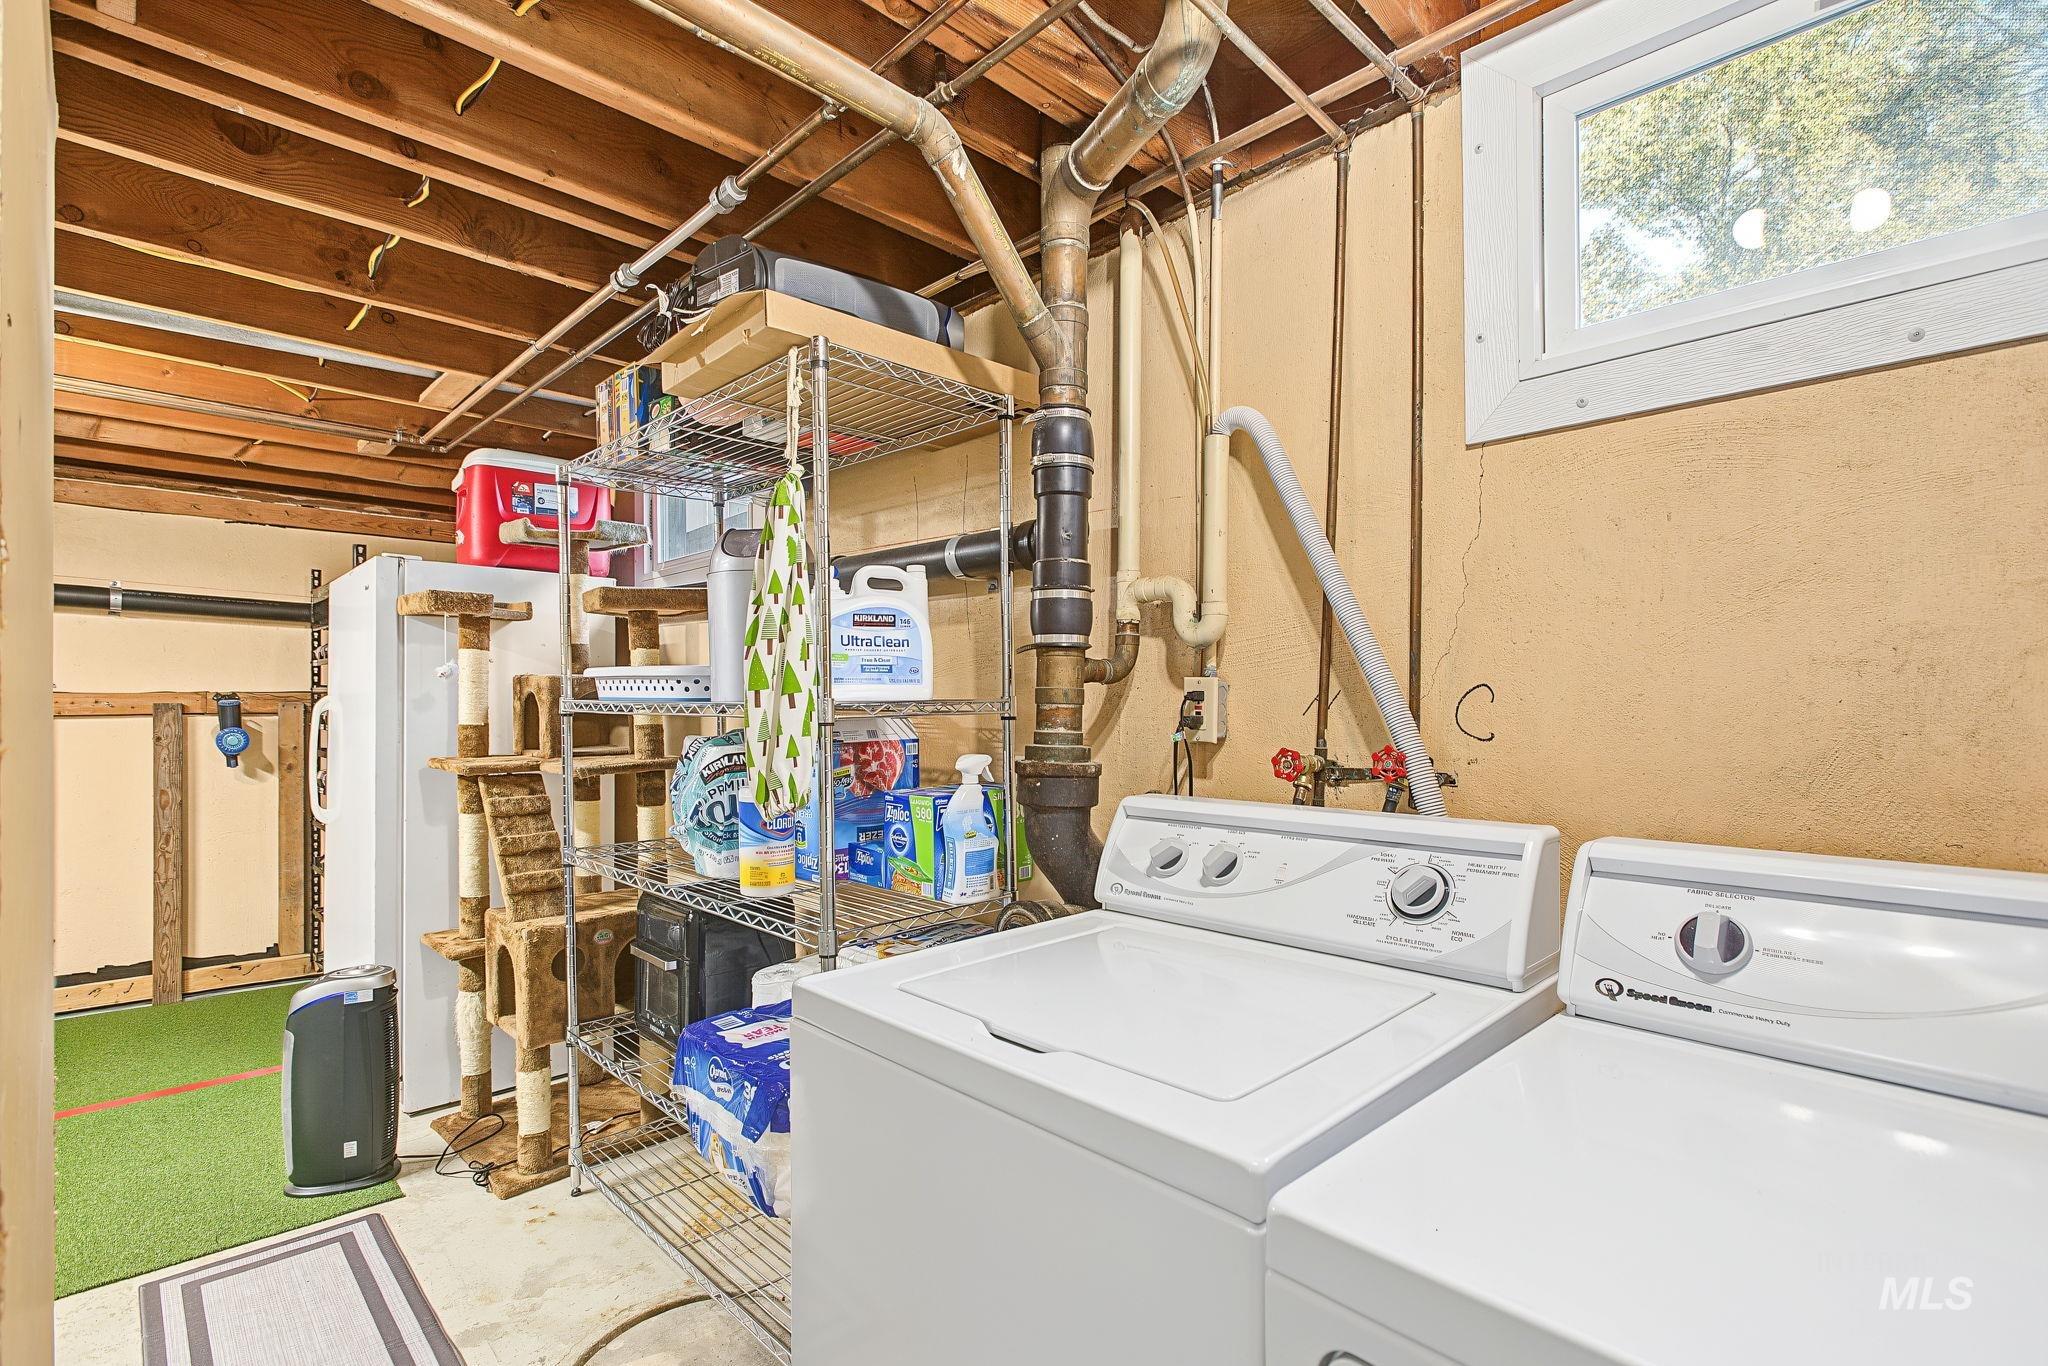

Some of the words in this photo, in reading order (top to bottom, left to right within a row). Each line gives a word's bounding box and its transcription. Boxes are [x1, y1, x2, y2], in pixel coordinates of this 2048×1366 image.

[853, 614, 895, 623] KIRKLAND
[840, 634, 910, 648] UltraClean
[886, 804, 910, 823] Ziploc
[767, 817, 794, 830] CLORO
[858, 830, 884, 842] EZER
[1715, 891, 1756, 901] SELECTOR
[1625, 988, 1667, 1004] Speed
[1668, 996, 1712, 1013] Queen
